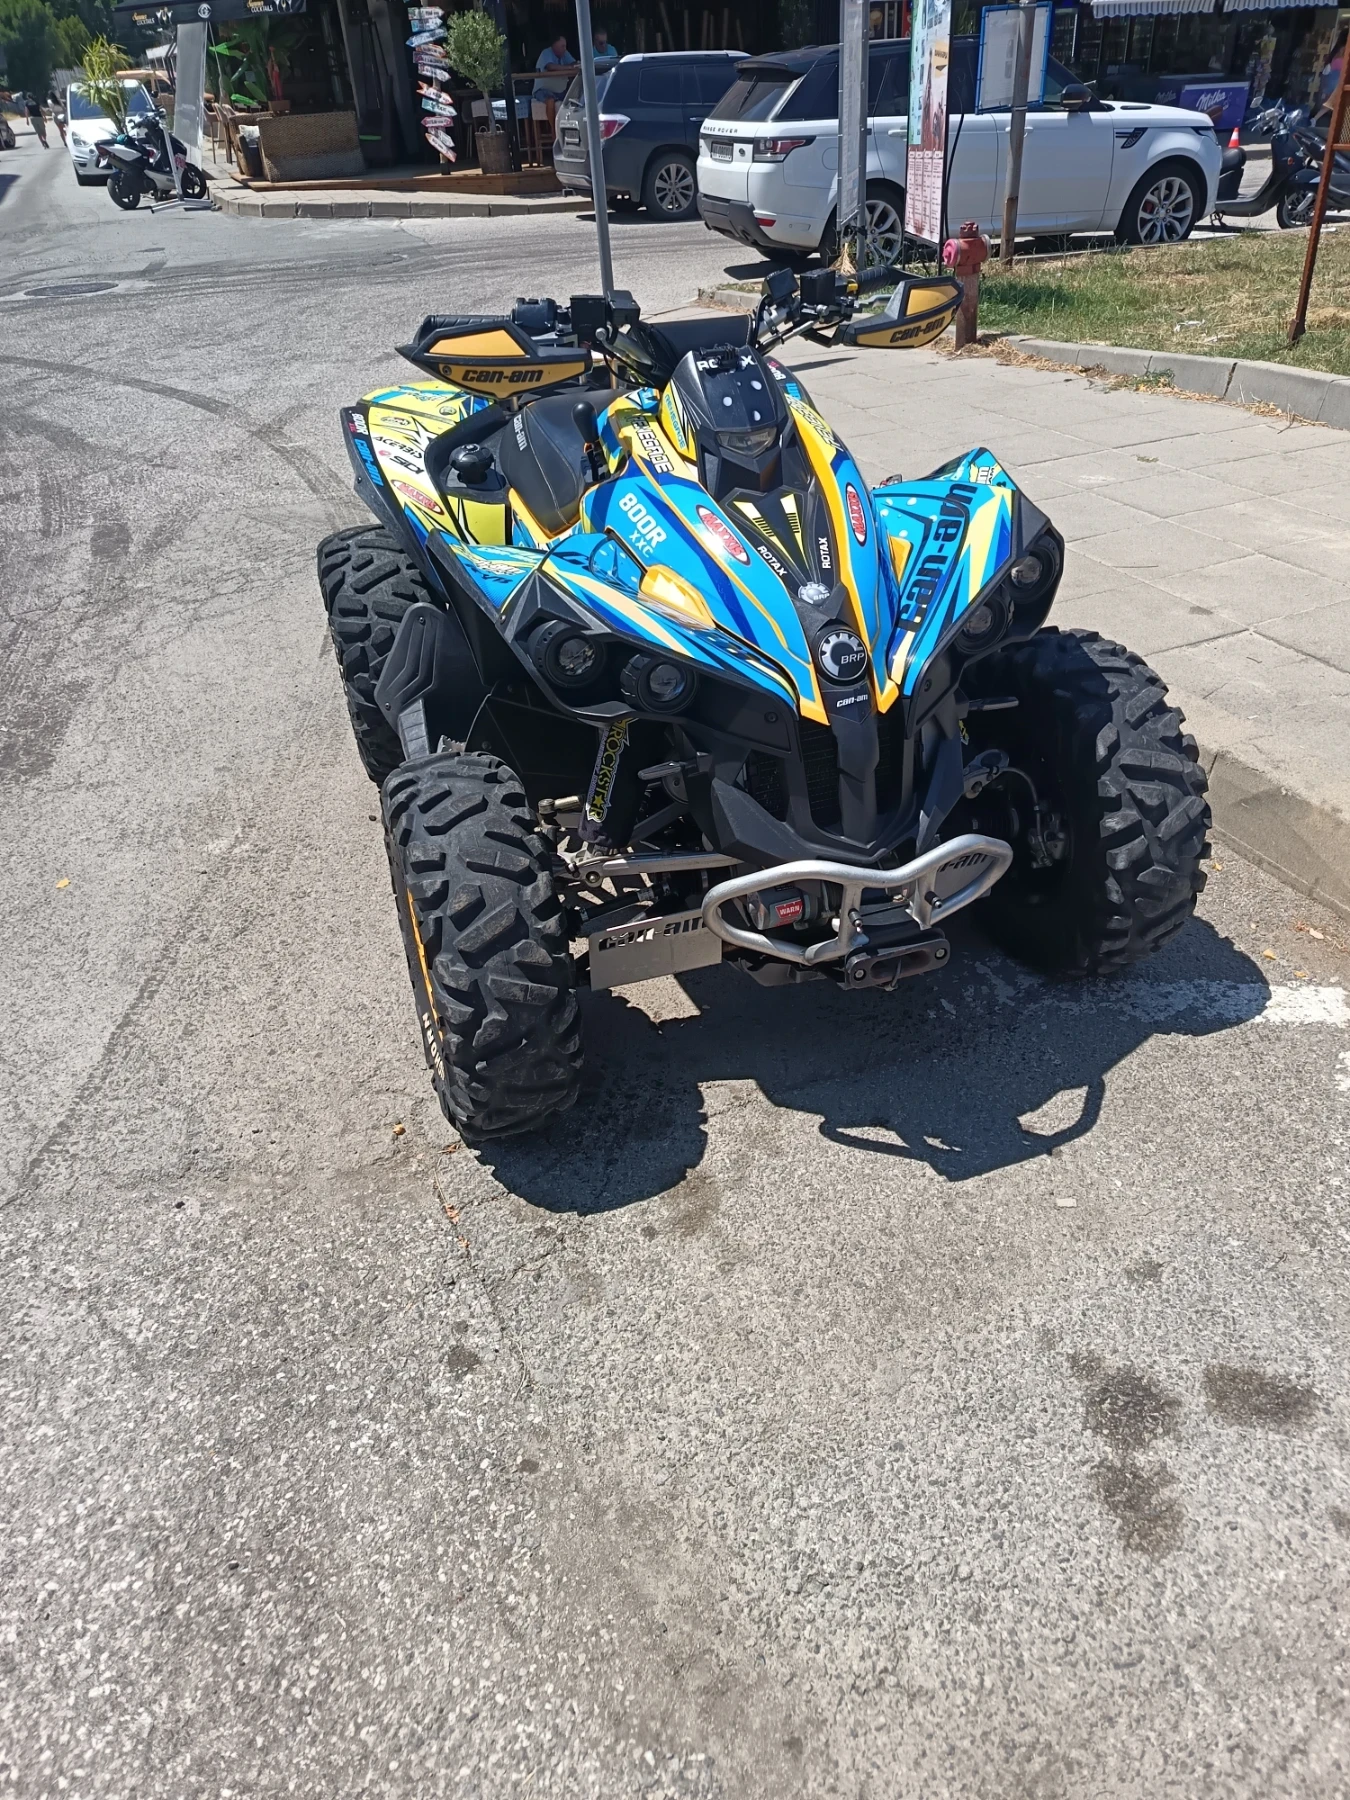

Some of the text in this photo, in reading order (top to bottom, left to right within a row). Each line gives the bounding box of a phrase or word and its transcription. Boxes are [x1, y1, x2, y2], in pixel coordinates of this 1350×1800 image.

[1196, 89, 1226, 111] Milka
[889, 316, 946, 343] can-am
[461, 369, 544, 383] can-am
[696, 355, 757, 371] ROX
[513, 414, 528, 451] can-am
[354, 438, 385, 487] can-am
[397, 481, 438, 511] MAXXIS
[618, 492, 668, 549] 800R
[847, 490, 866, 535] MAXXIS
[628, 530, 654, 558] XXC
[701, 512, 744, 557] MAXXIS
[756, 545, 788, 577] ROTAX
[818, 536, 832, 569] ROTAX
[896, 483, 978, 632] can-am
[813, 592, 830, 601] BRP
[841, 652, 865, 665] BRP
[836, 694, 868, 708] can-am
[779, 905, 800, 916] WARN
